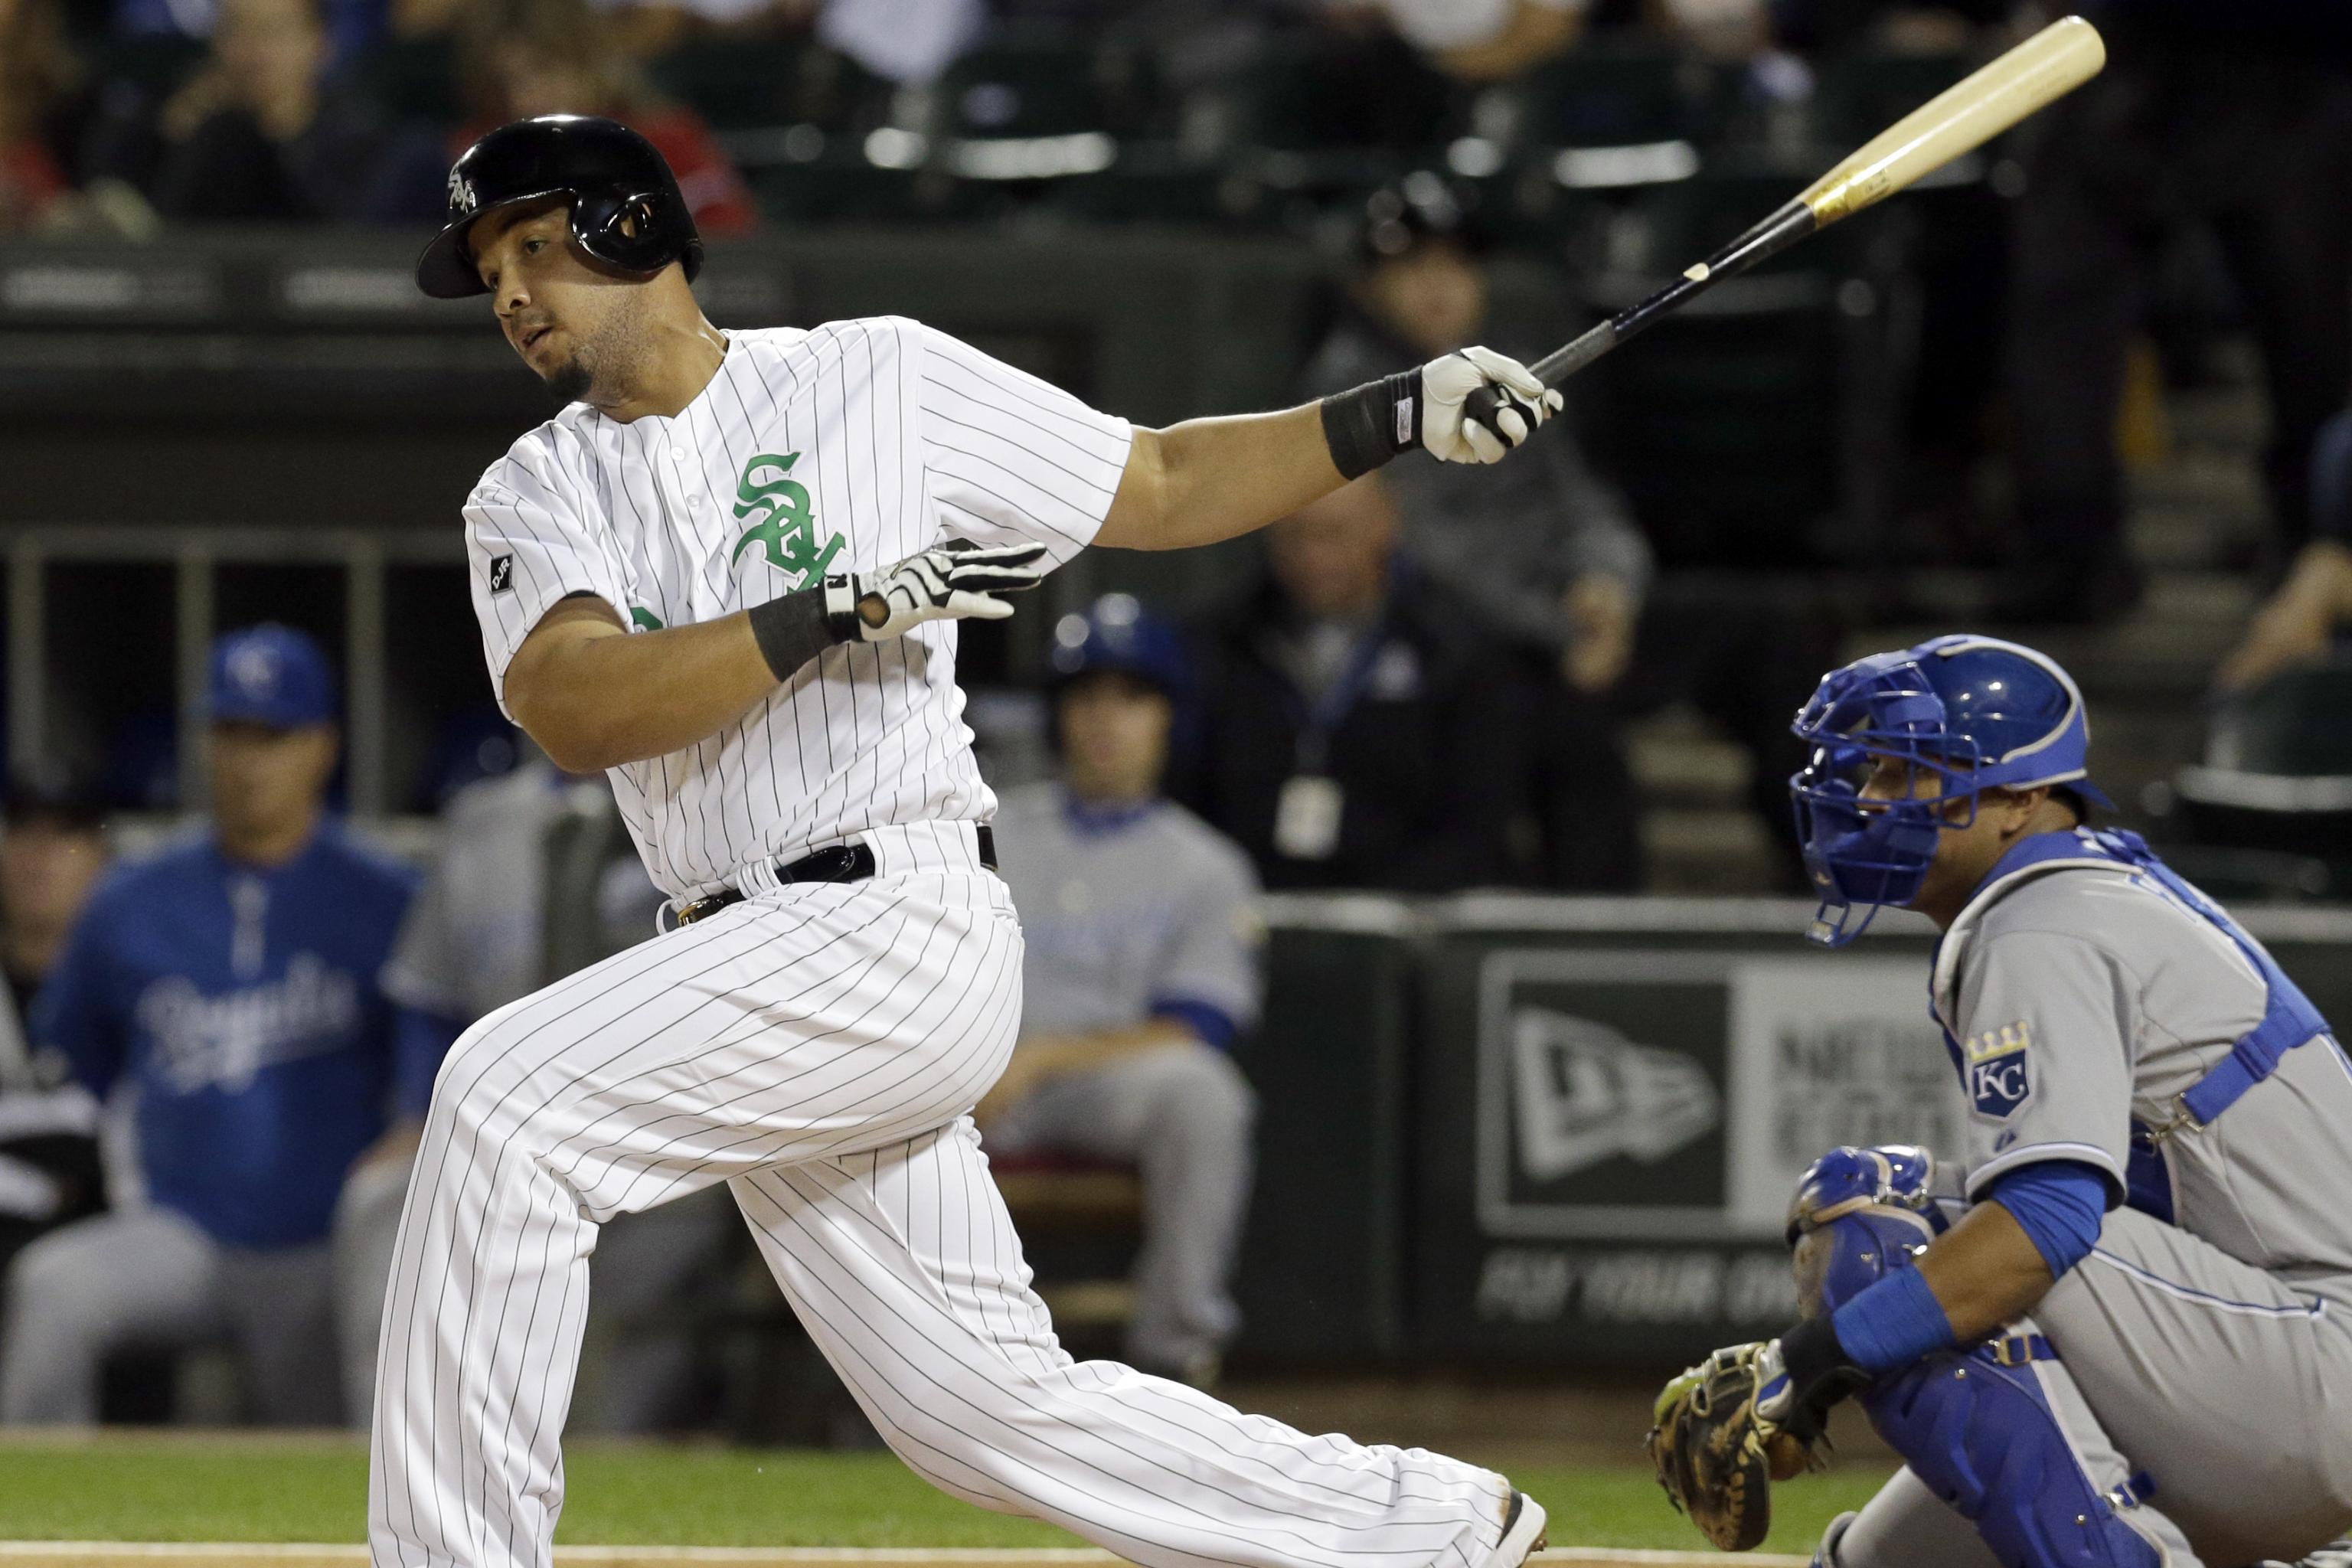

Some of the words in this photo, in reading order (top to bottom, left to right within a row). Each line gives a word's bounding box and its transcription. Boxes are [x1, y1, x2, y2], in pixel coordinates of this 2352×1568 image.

[732, 452, 846, 595] Sox
[492, 558, 510, 590] DJR
[1974, 1060, 2026, 1101] KC
